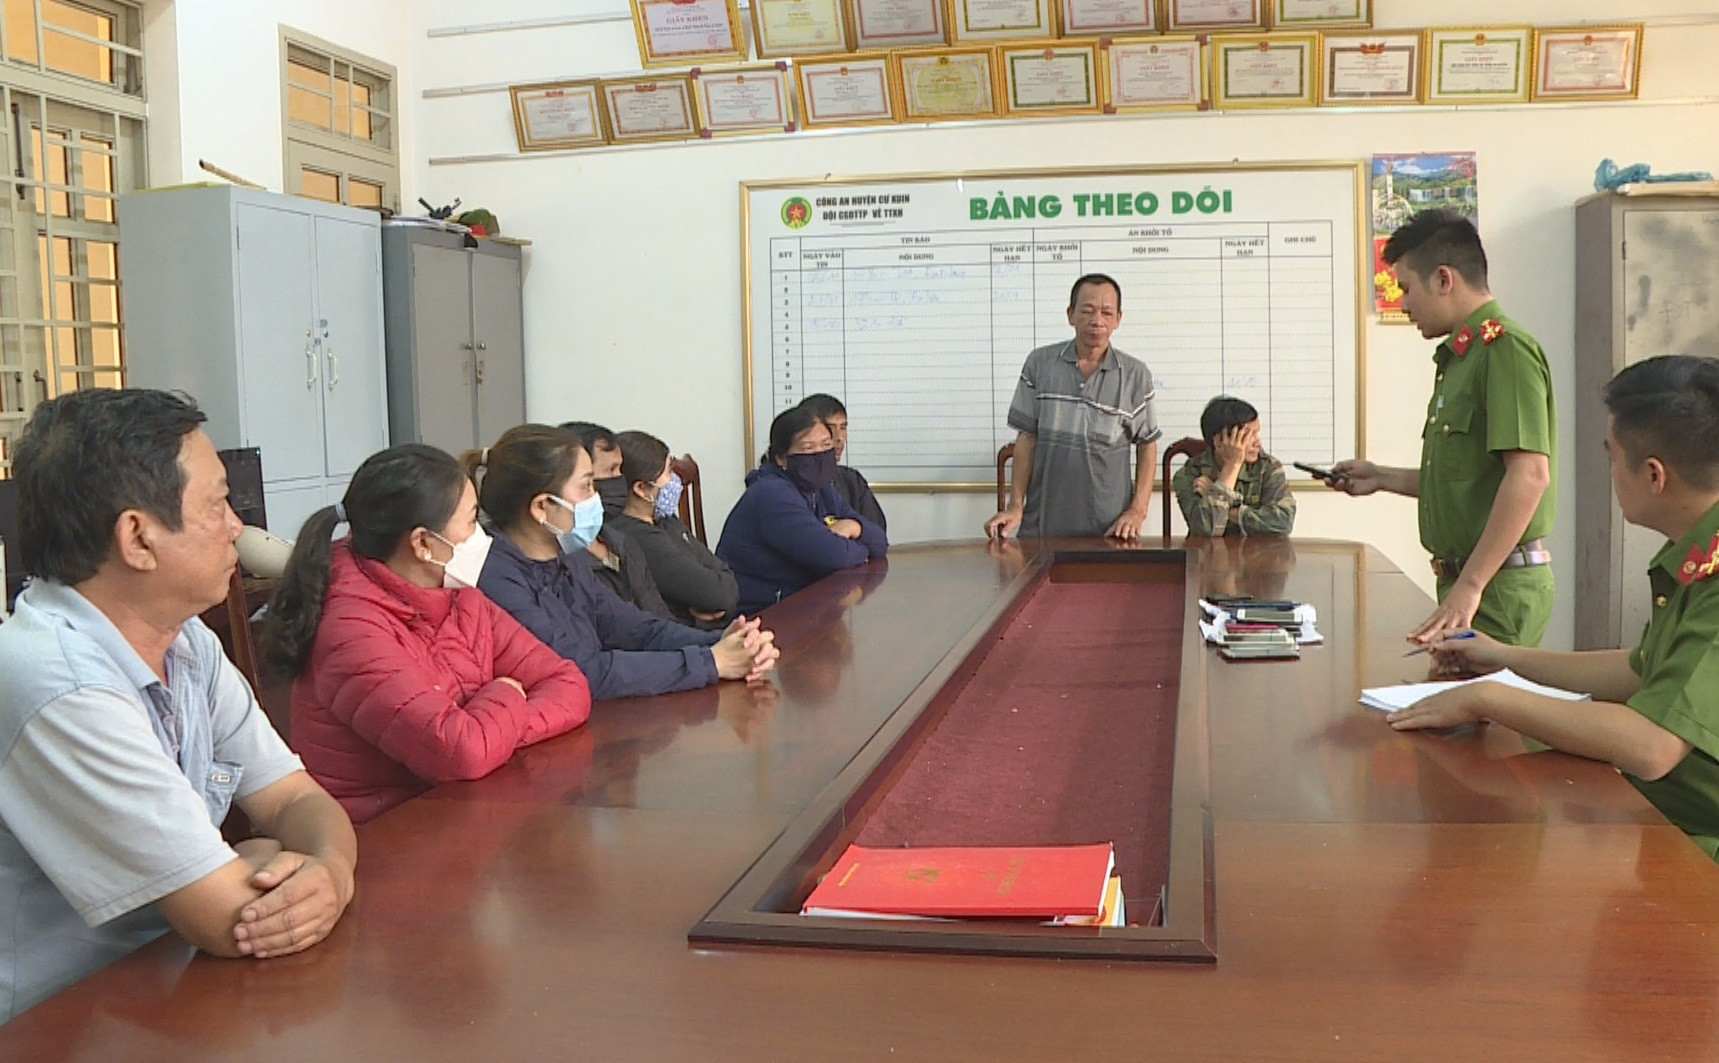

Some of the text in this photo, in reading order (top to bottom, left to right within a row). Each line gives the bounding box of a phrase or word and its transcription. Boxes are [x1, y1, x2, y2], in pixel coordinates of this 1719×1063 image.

[816, 196, 837, 207] CÔNG
[839, 196, 850, 206] AN
[852, 194, 877, 207] HUYỆN
[891, 194, 910, 204] KUIN
[969, 190, 1063, 220] BẢNG
[1073, 191, 1159, 217] THEO
[884, 208, 903, 219] TTXH
